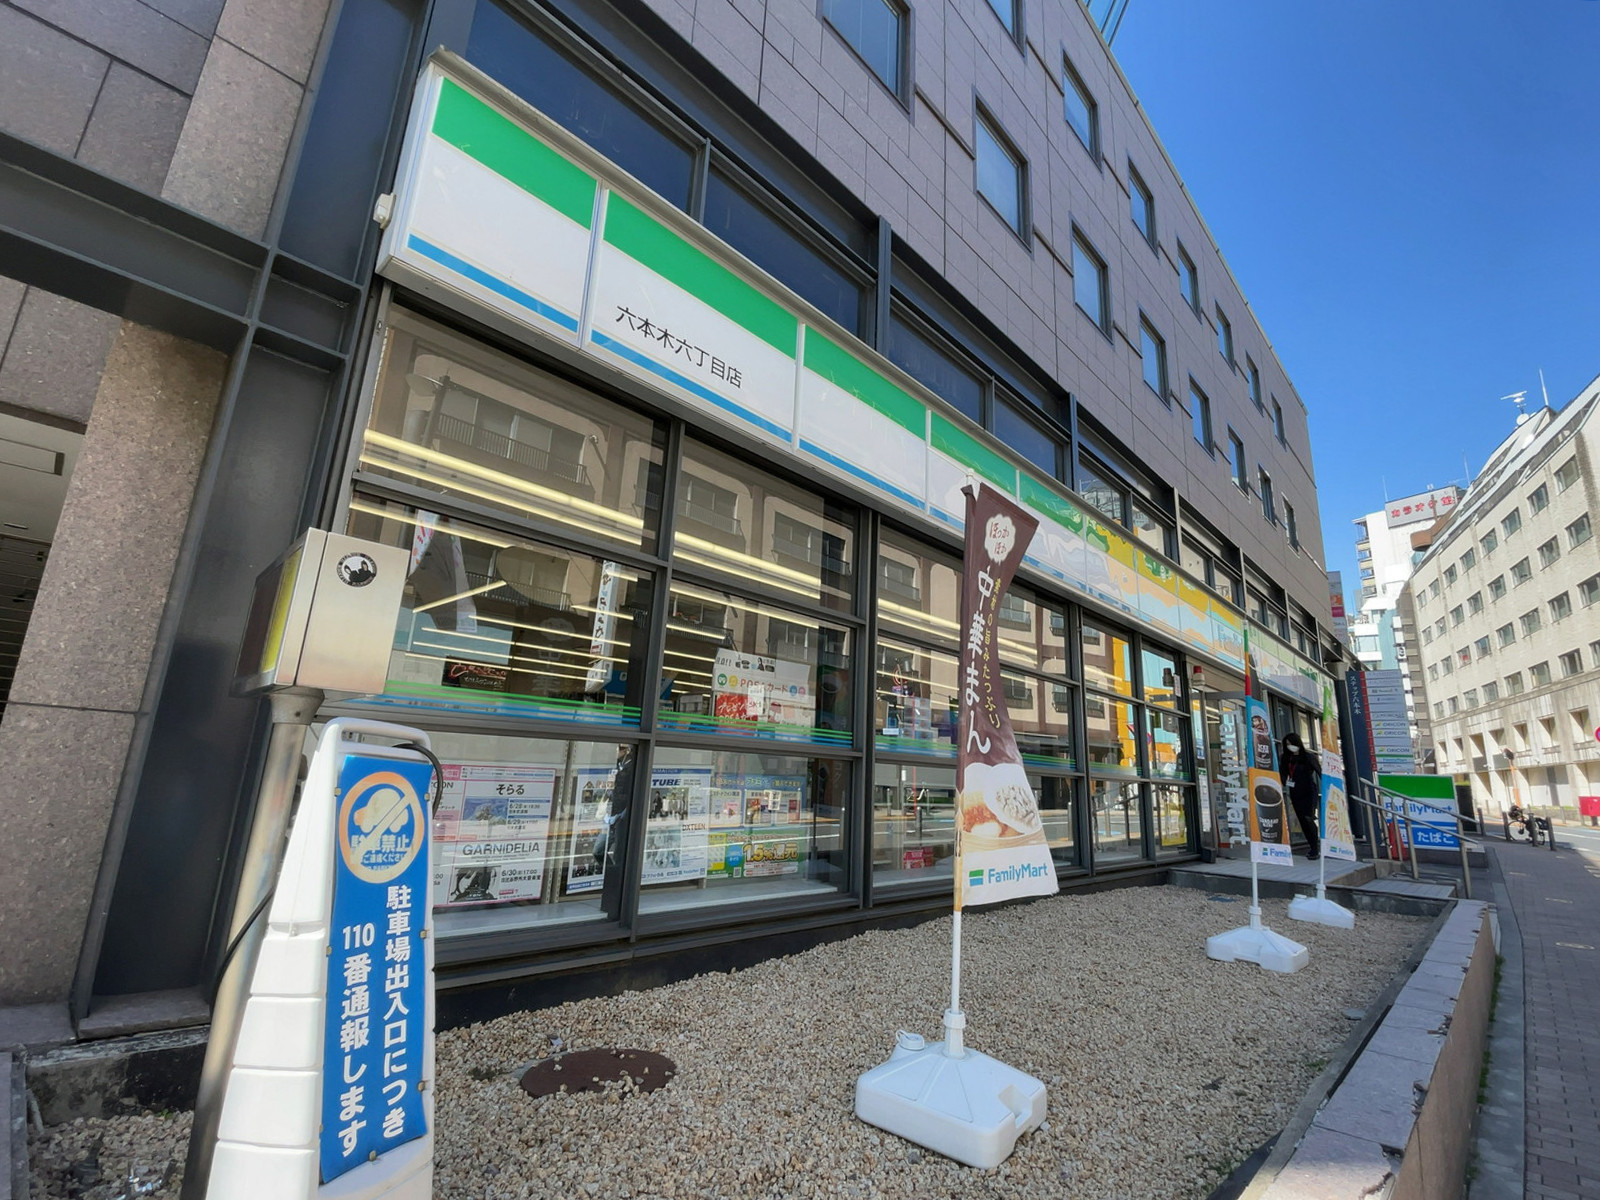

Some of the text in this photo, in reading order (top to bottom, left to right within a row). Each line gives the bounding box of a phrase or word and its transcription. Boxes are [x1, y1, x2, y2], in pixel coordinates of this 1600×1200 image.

[615, 305, 743, 390] 六本木六丁目店
[964, 564, 995, 756] 中華まん
[496, 784, 525, 796] そらる
[652, 779, 681, 787] TUBE
[1417, 831, 1454, 844] たばこ
[988, 862, 1049, 884] FamilyMart
[382, 885, 413, 1139] 駐車場出入口につき
[338, 921, 375, 1158] 110番通報します
